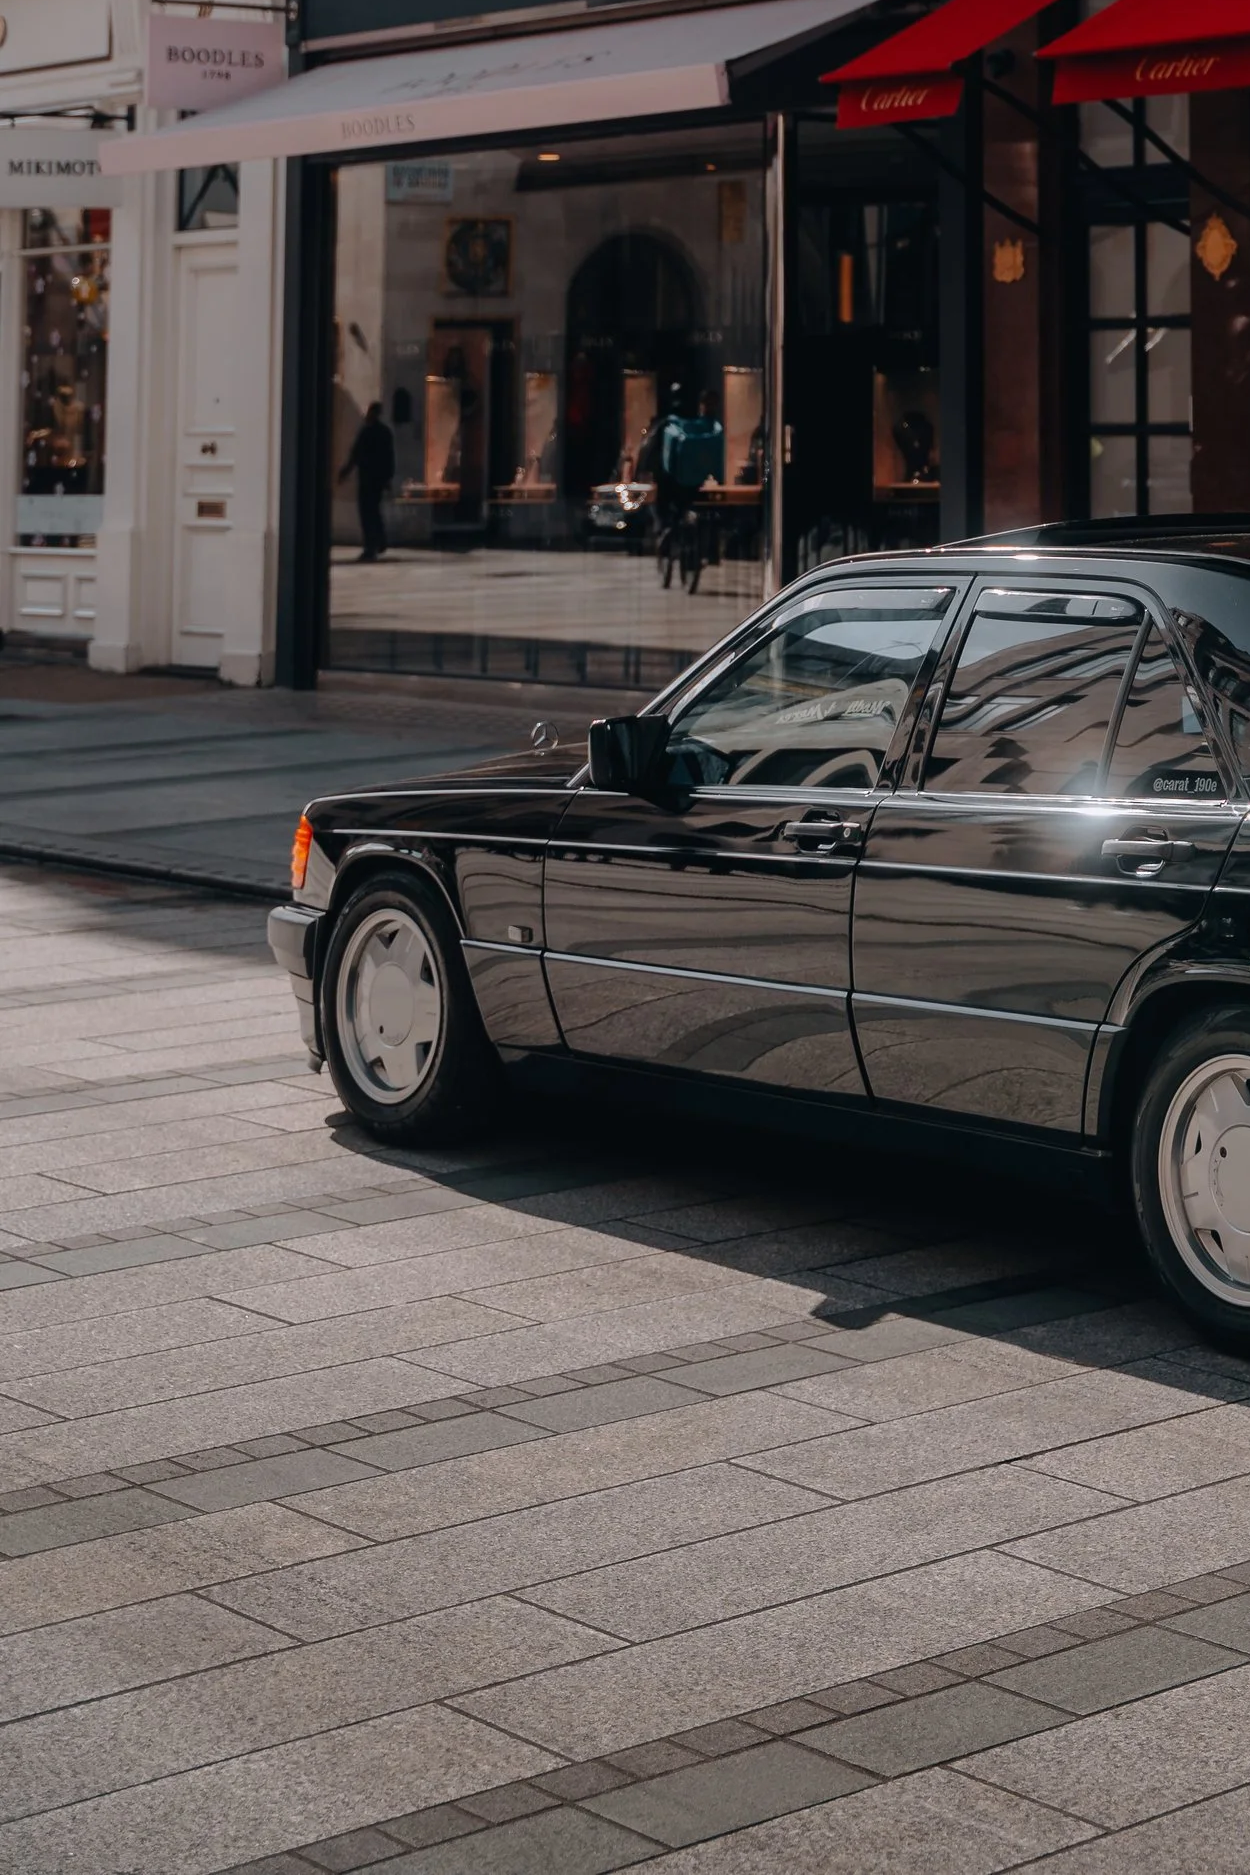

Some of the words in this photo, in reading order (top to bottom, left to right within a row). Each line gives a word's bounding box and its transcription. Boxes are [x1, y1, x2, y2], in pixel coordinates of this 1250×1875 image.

[166, 44, 265, 69] BOODLES
[1135, 52, 1221, 83] Cartier
[860, 85, 932, 113] Cartier
[341, 113, 416, 140] BOODLES
[8, 159, 101, 176] MIKIMOT
[1153, 777, 1217, 794] @carat_190e
